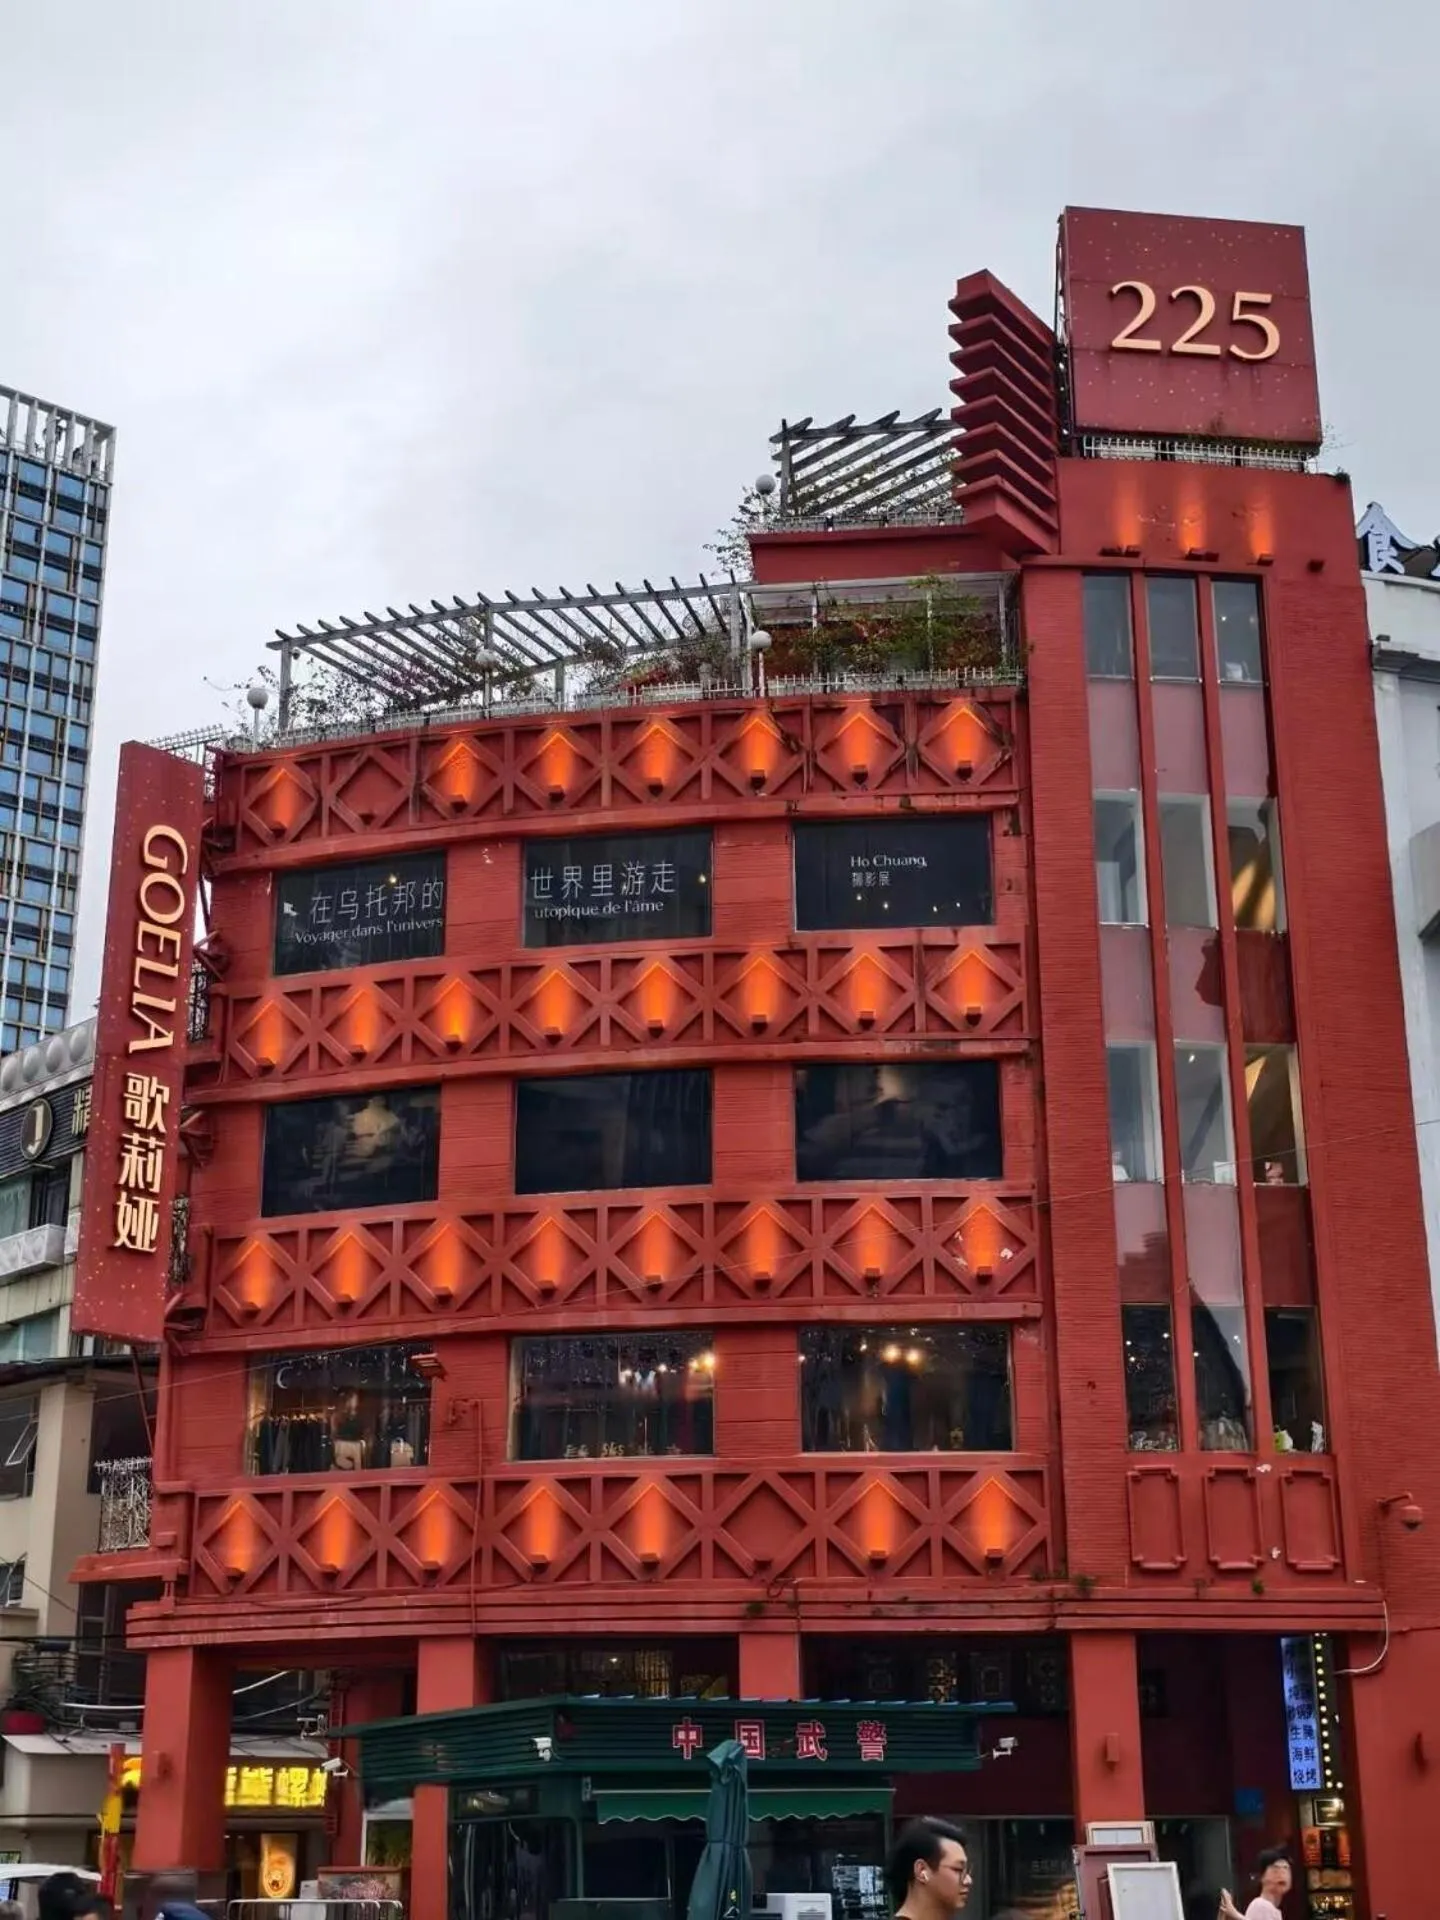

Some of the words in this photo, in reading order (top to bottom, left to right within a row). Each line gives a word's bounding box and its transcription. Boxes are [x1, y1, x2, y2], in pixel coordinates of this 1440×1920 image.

[1110, 281, 1281, 360] 225
[309, 875, 444, 925] 在乌托邦的
[530, 859, 676, 900] 世界里游走
[294, 928, 351, 946] Voyager
[351, 923, 383, 938] dans
[386, 916, 444, 934] l'univers
[534, 904, 600, 921] utopique
[602, 901, 621, 915] de
[625, 899, 664, 913] l'âme
[129, 823, 188, 1055] GOELIA
[113, 1071, 171, 1254] 歌莉娅
[672, 1716, 888, 1762] 中国武警
